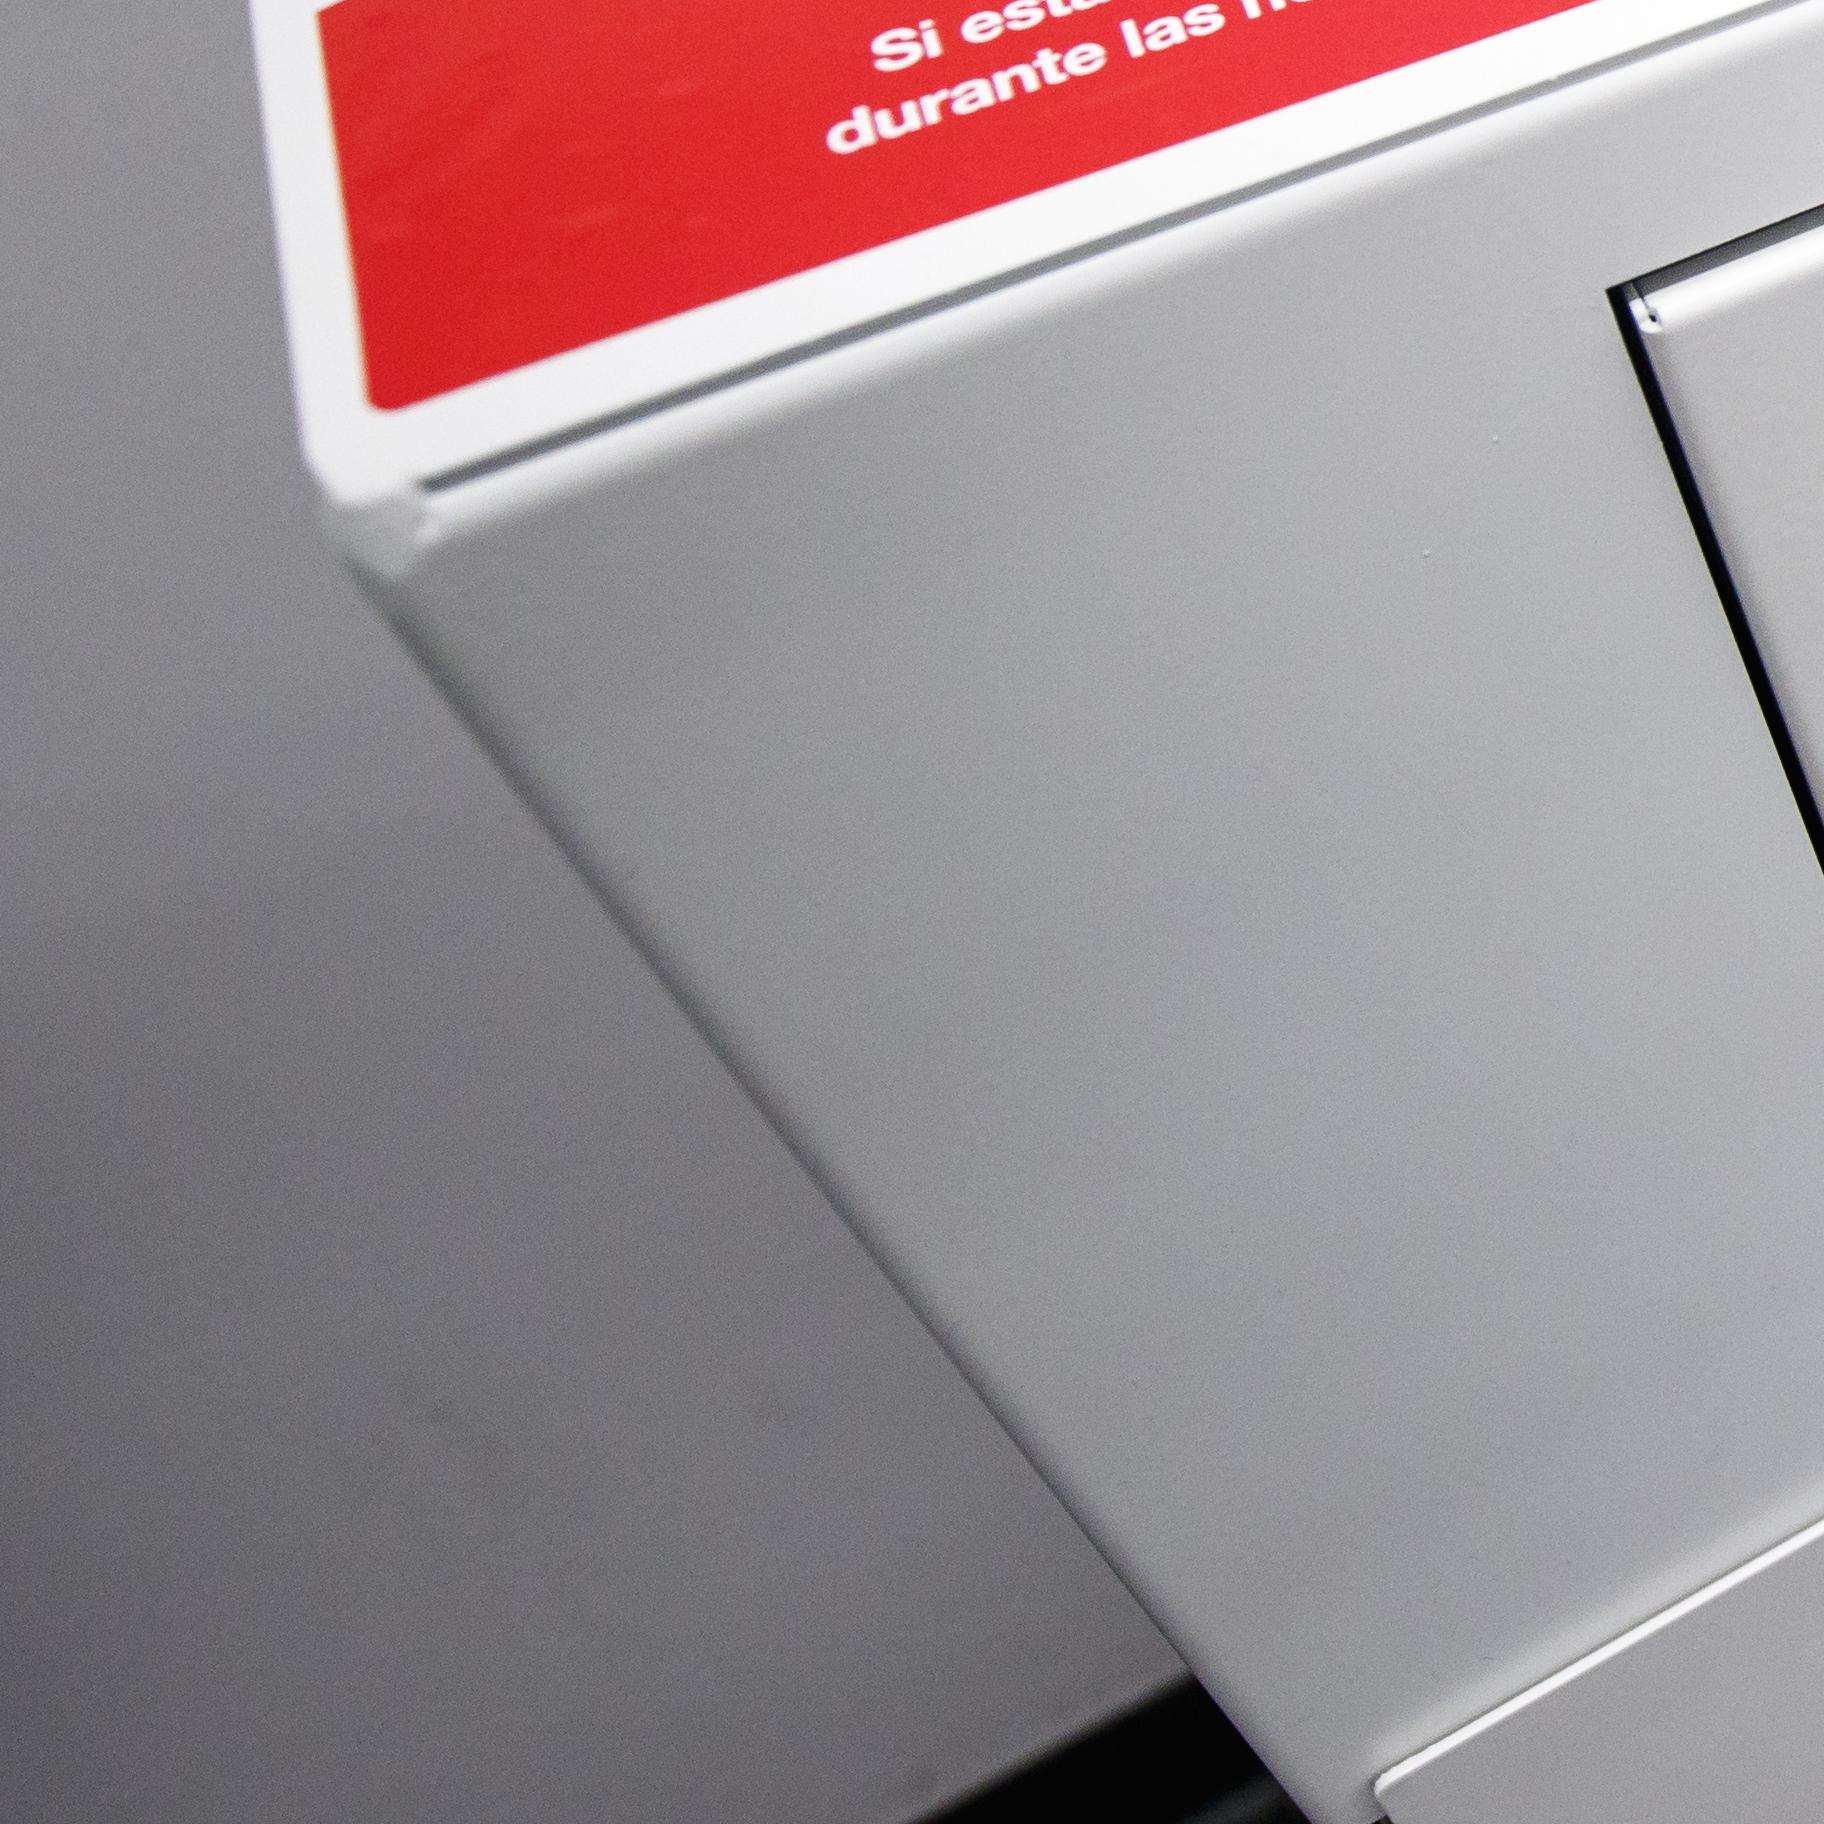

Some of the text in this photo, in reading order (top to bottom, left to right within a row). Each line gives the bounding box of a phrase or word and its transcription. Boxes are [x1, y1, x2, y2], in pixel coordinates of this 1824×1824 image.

[827, 43, 1106, 154] durante
[1121, 4, 1225, 57] las
[871, 19, 943, 71] Si
